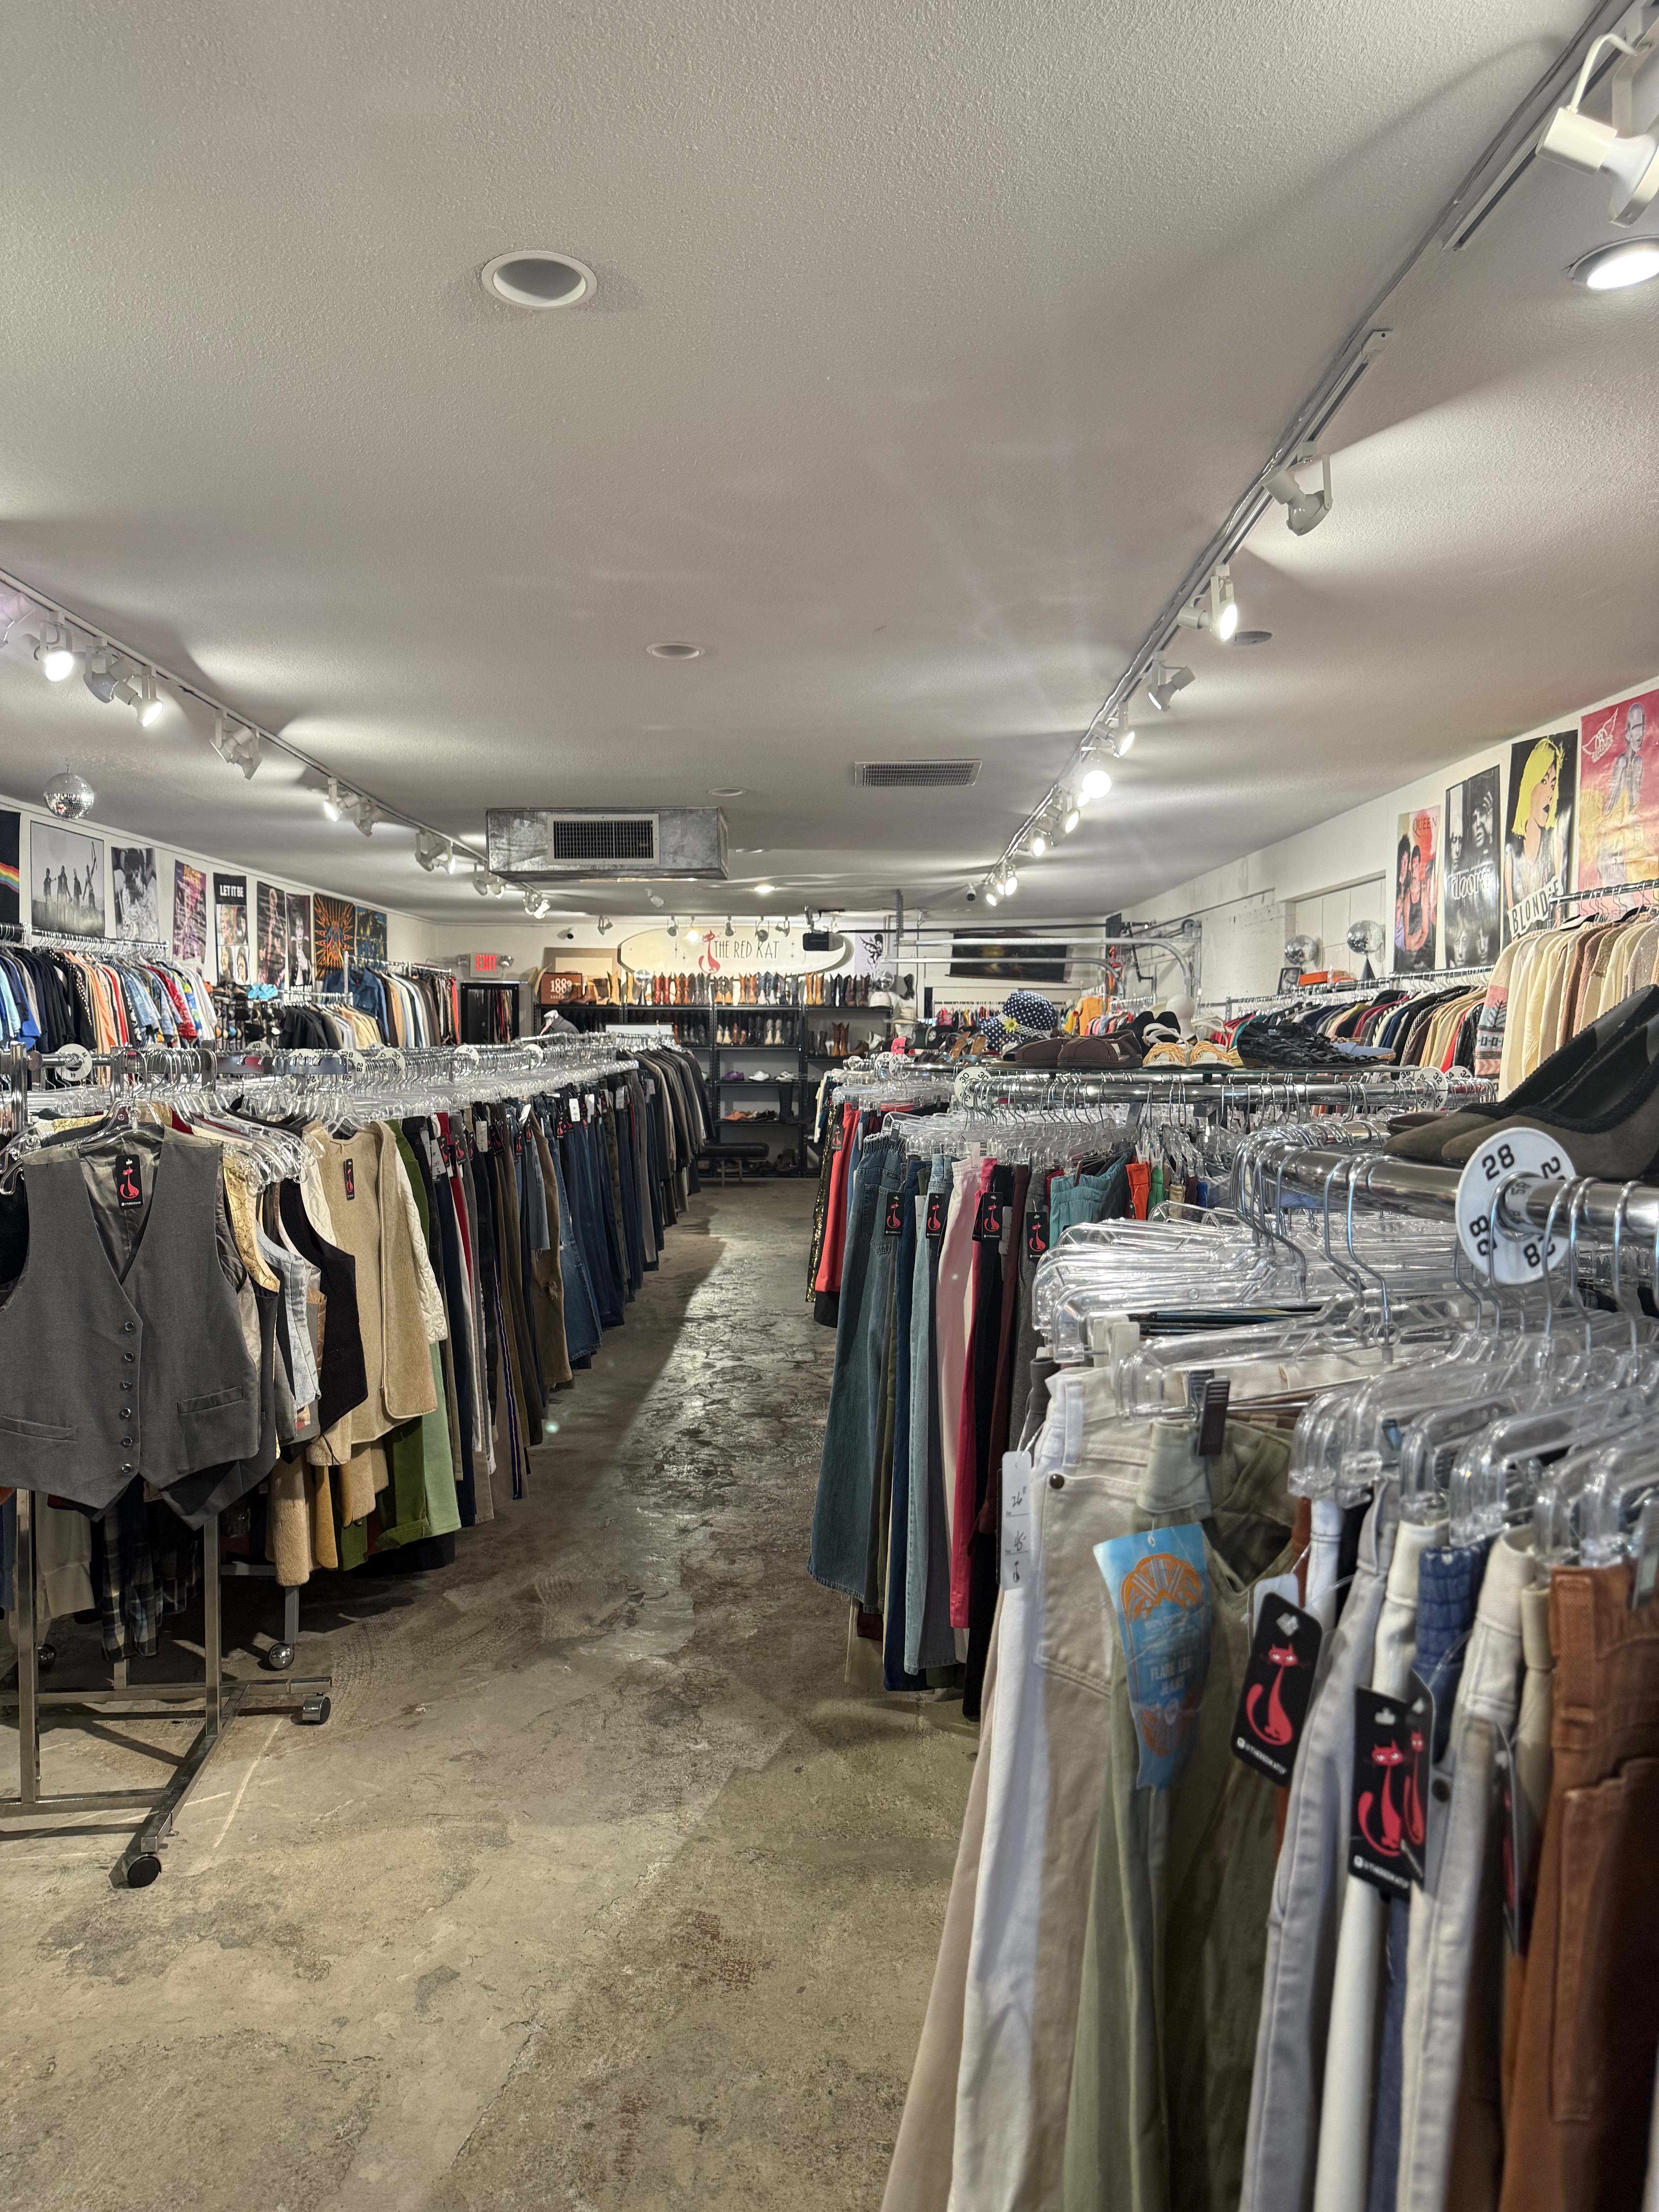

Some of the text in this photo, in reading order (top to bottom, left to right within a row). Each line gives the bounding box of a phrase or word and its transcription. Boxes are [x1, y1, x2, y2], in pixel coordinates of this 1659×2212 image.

[1412, 816, 1437, 838] QUEEN
[220, 884, 244, 898] LET IT BE
[714, 940, 779, 959] THE RED KAT
[476, 954, 497, 971] EXIT
[392, 1051, 401, 1060] 30
[357, 1062, 363, 1072] 28
[959, 1072, 970, 1083] 30
[1433, 1072, 1443, 1085] 32
[1481, 1144, 1515, 1181] 28
[1540, 1156, 1567, 1180] 2
